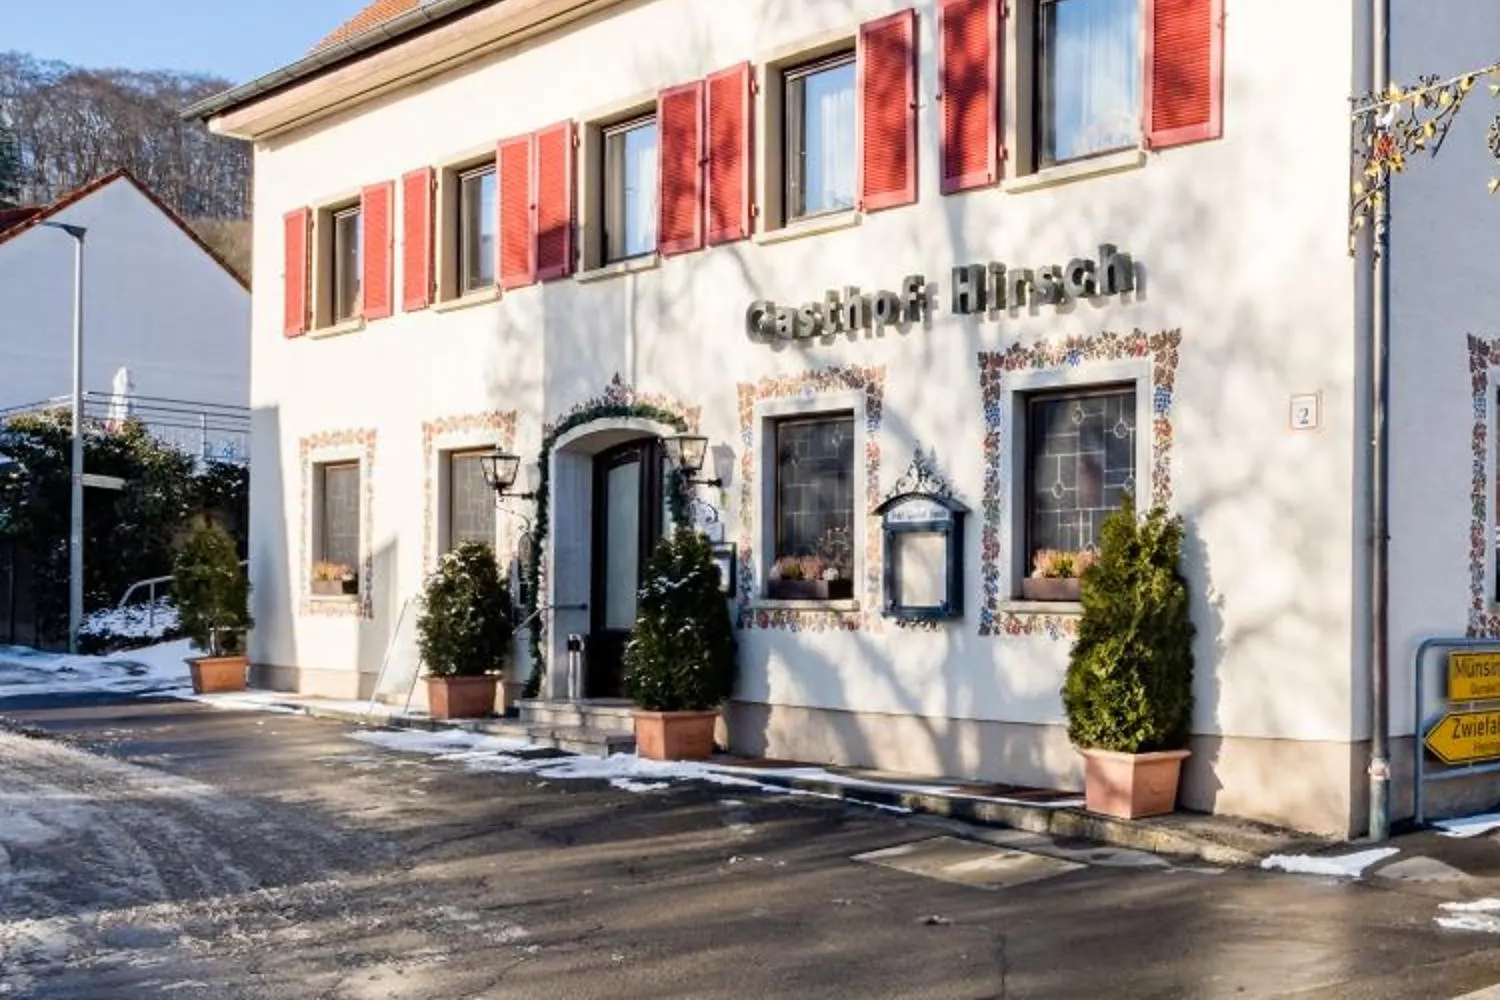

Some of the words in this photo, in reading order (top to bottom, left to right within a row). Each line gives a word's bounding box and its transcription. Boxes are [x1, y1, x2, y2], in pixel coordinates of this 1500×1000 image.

[746, 273, 926, 344] Gasthof
[951, 243, 1138, 315] Hirsch
[1299, 407, 1308, 425] 2
